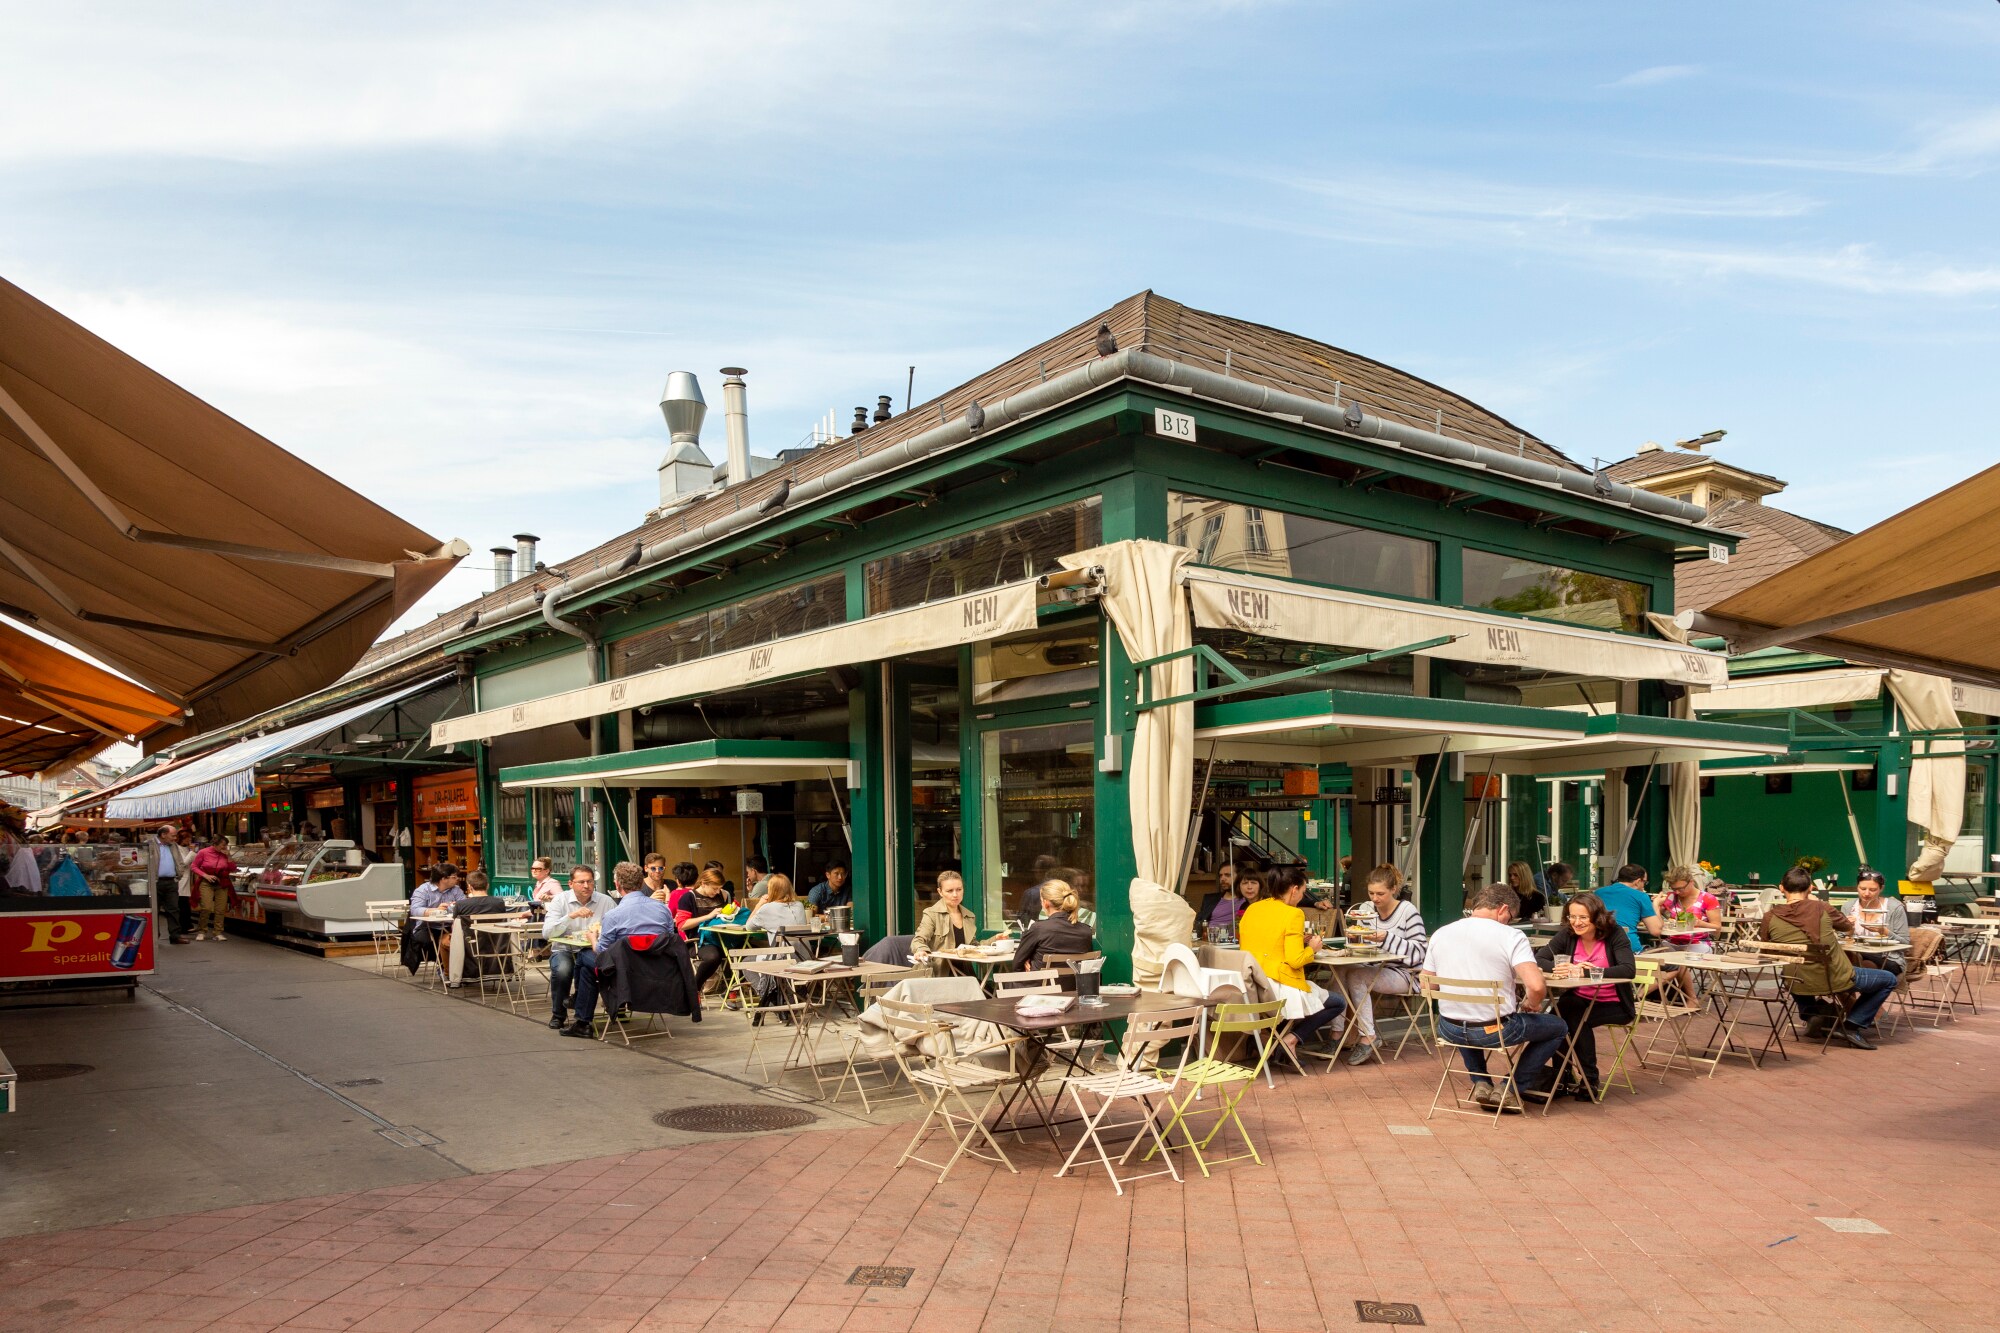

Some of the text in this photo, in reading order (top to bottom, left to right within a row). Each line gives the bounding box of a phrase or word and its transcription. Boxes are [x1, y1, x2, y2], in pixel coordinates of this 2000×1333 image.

[1162, 414, 1189, 436] B 13
[1712, 546, 1718, 559] B
[963, 595, 998, 628] NENI
[1227, 588, 1269, 620] NENI
[1487, 627, 1521, 653] NENI
[748, 646, 774, 672] NENI
[1680, 653, 1709, 675] NENI
[609, 681, 628, 702] NENI
[512, 706, 525, 724] NENI
[503, 844, 529, 861] You are
[543, 842, 565, 859] what
[53, 951, 143, 965] spezialitn
